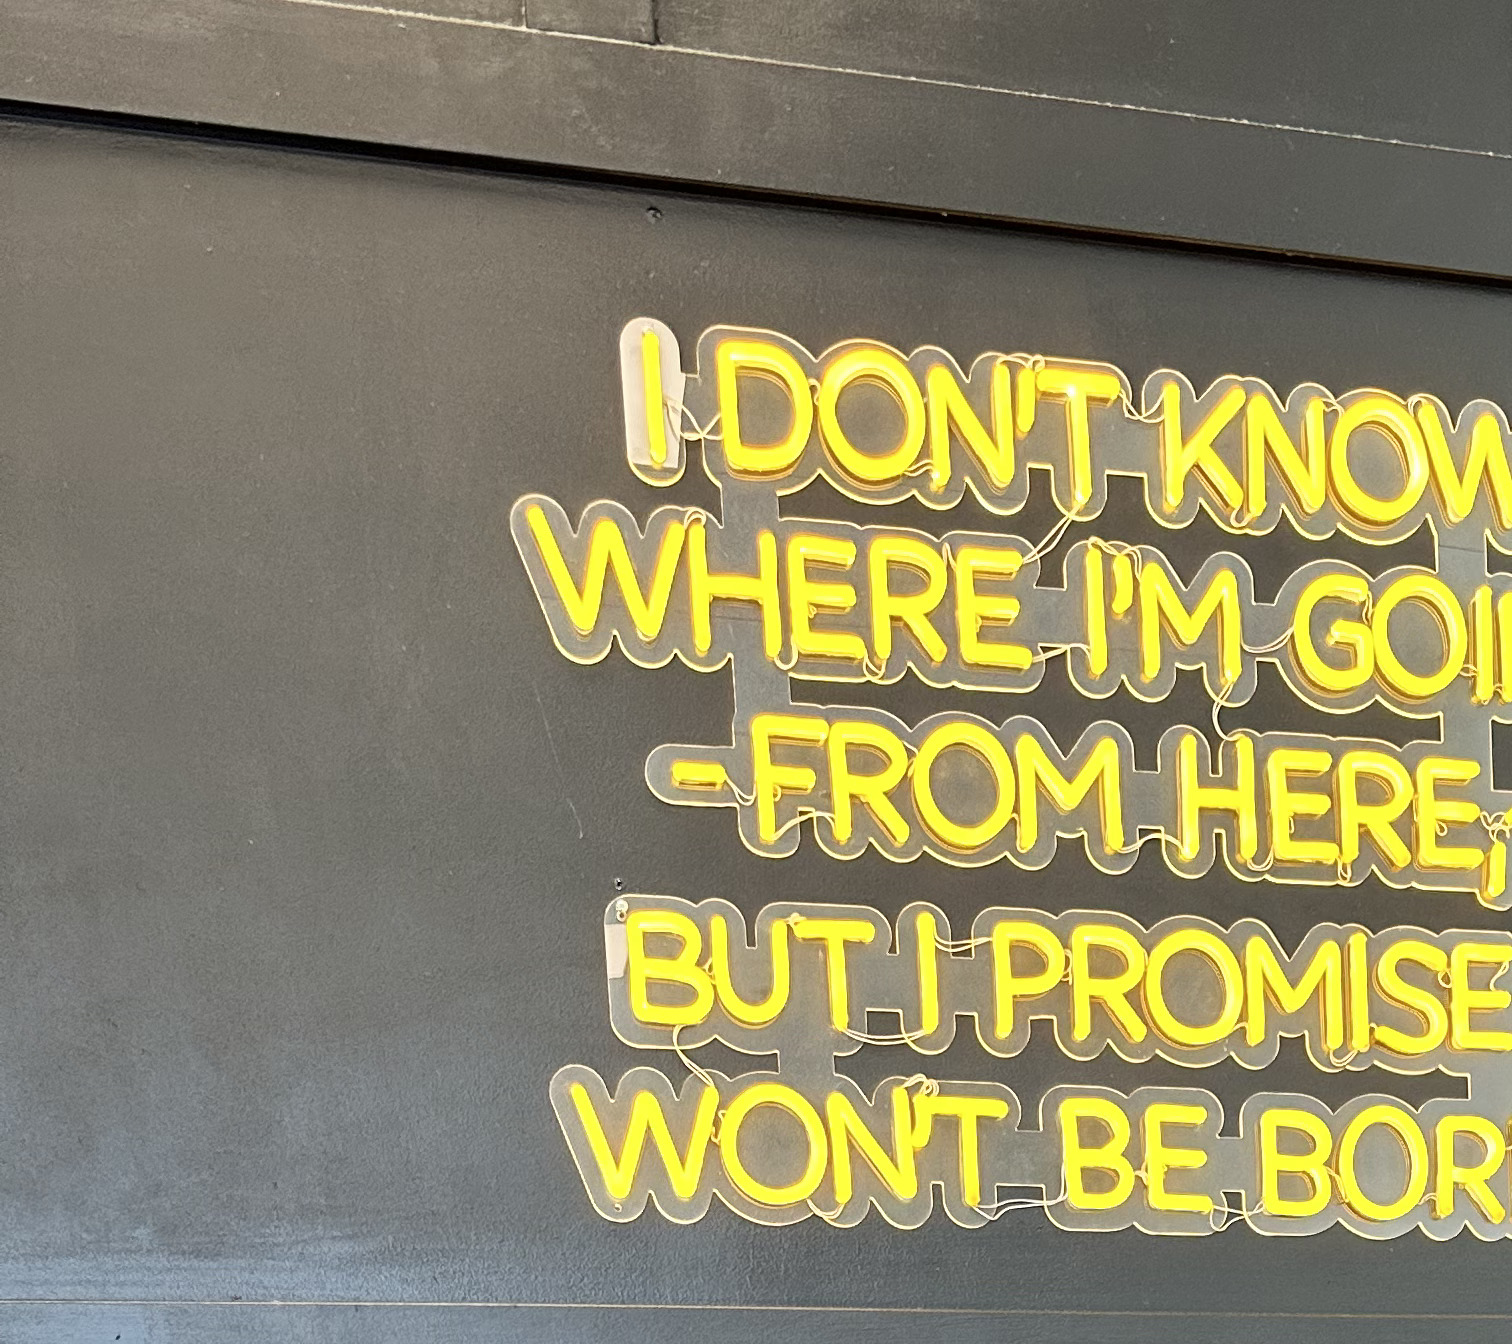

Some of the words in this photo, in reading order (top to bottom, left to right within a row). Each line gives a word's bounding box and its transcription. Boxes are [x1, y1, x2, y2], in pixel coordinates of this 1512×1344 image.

[640, 332, 669, 471] I
[712, 336, 1124, 512] DON'T
[524, 504, 1036, 673] WHERE
[1082, 544, 1244, 690] I'M
[624, 908, 876, 1036] BUT
[914, 910, 940, 1037] I
[570, 1080, 1010, 1210] WON'T
[1060, 1096, 1216, 1217] BE
